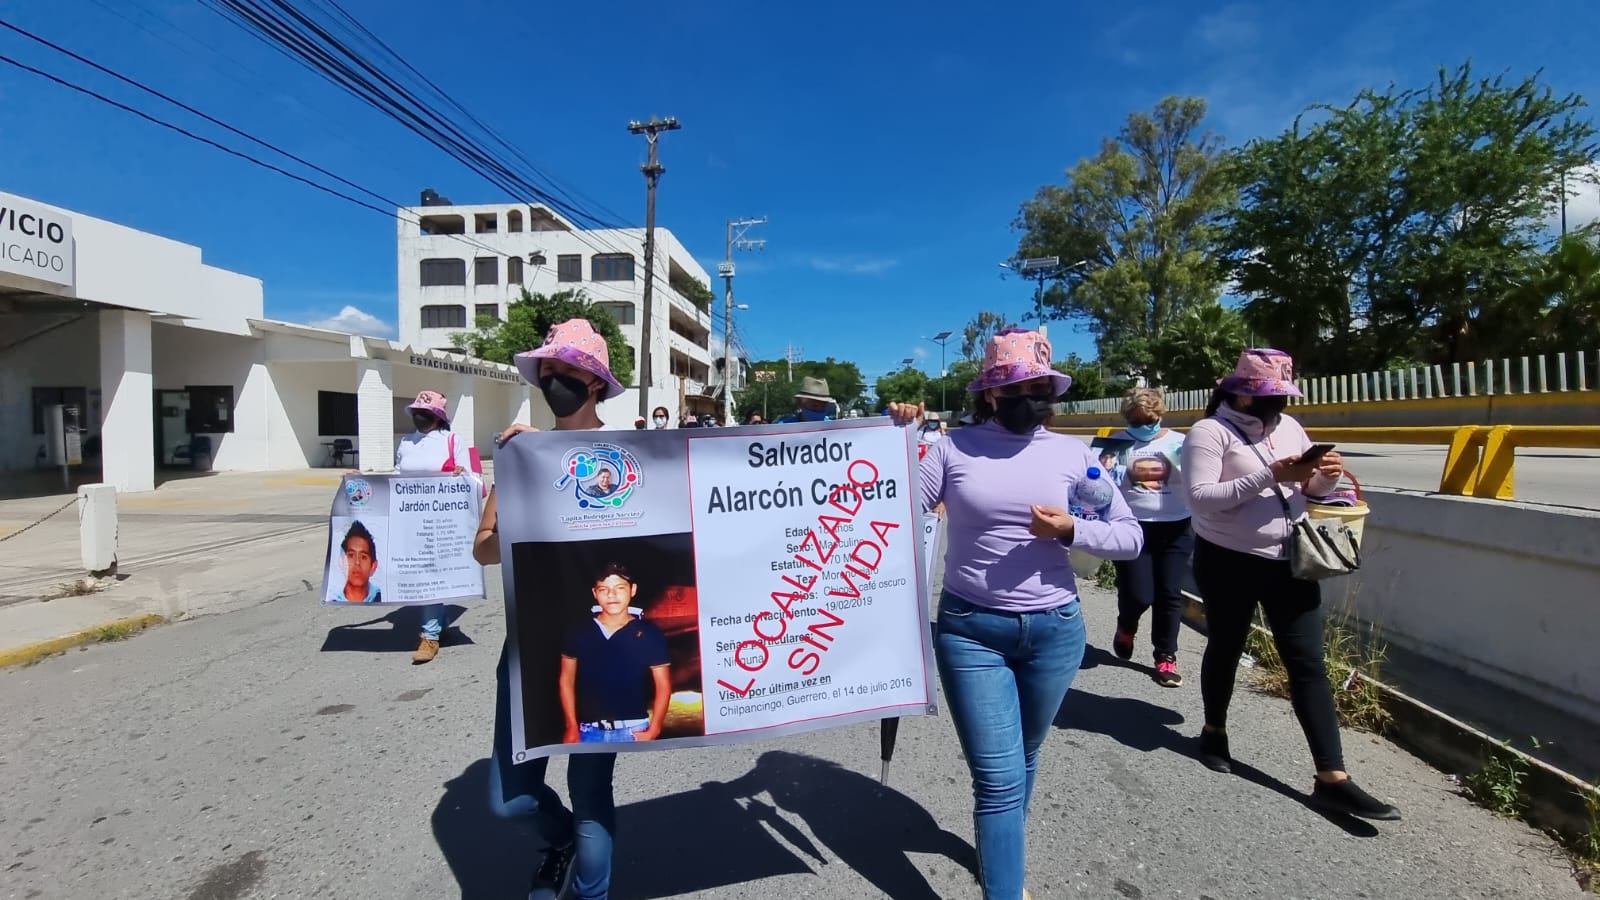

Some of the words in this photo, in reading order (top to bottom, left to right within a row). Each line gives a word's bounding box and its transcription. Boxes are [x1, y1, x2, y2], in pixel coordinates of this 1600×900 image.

[410, 355, 487, 377] ESTACIONAMIENTO
[489, 370, 520, 383] CLIENTES
[748, 437, 852, 468] Salvador
[395, 482, 436, 495] Cristhian
[437, 482, 472, 494] Aristeo
[707, 480, 803, 514] Alarcón
[811, 478, 897, 506] Carrera
[399, 500, 430, 513] Jardón
[432, 499, 470, 512] Cuenca
[818, 537, 865, 551] Maculin
[717, 459, 879, 697] LOCALIZADO
[770, 557, 816, 572] Estatur:
[787, 608, 845, 676] SIN
[829, 520, 900, 599] VIDA
[858, 580, 877, 591] café
[878, 577, 906, 589] oscuro
[710, 614, 743, 627] Fecha
[744, 612, 757, 623] de
[825, 596, 874, 612] 19/02/2019
[719, 698, 784, 717] Chilpancingo,
[786, 690, 830, 706] Guerrero,
[832, 688, 841, 698] el
[844, 685, 855, 696] 14
[857, 682, 869, 694] de
[870, 680, 888, 695] julio
[889, 678, 913, 690] 2016
[748, 687, 767, 700] por
[769, 682, 799, 696] última
[801, 678, 818, 690] vez
[819, 675, 832, 685] en
